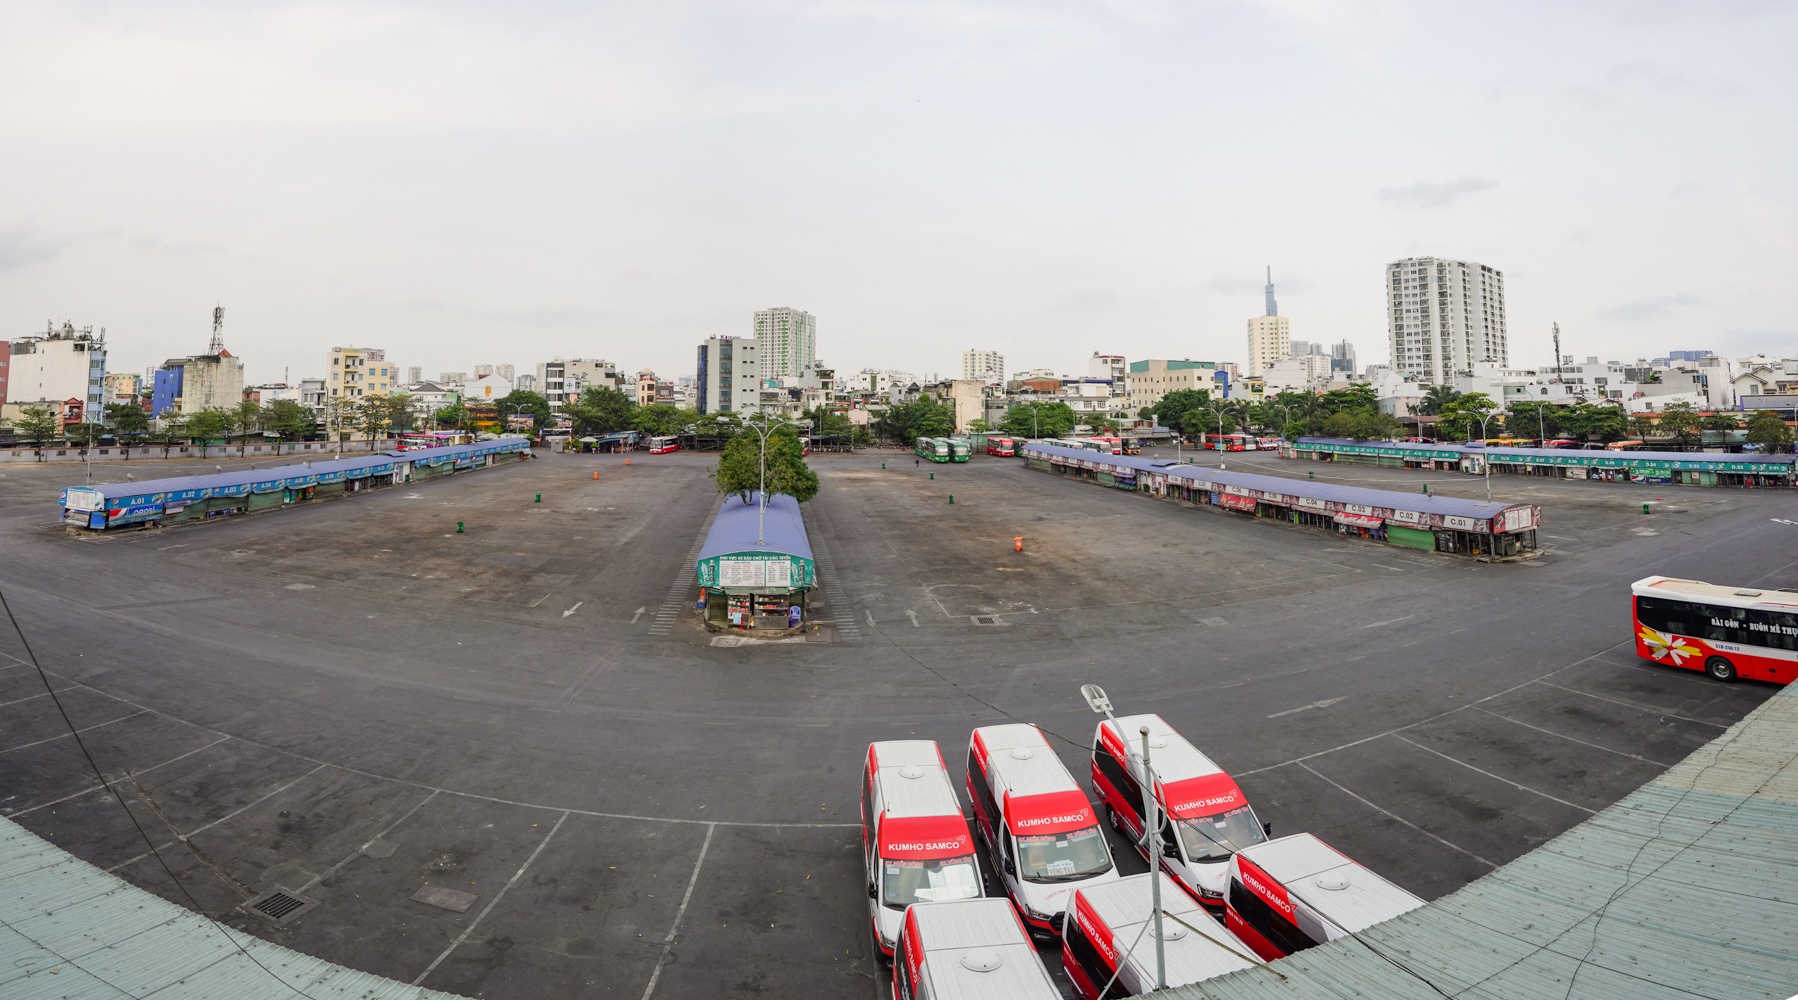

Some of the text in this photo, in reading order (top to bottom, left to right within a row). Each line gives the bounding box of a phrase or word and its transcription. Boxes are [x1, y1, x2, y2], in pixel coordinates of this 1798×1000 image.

[224, 486, 236, 494] A.03
[1400, 512, 1414, 520] C.02
[1450, 518, 1466, 526] C.01
[1711, 617, 1723, 626] SÀI
[1724, 618, 1739, 628] GÒN
[1749, 622, 1768, 632] BUÔN
[1174, 796, 1234, 812] KUMHO SAMCO
[1018, 814, 1084, 828] KUMHO SAMCO
[925, 842, 960, 850] SAMCO
[1243, 872, 1266, 894] KUMHO
[1266, 891, 1291, 912] SAMCO
[1078, 910, 1114, 960] KUMHO SAMCO
